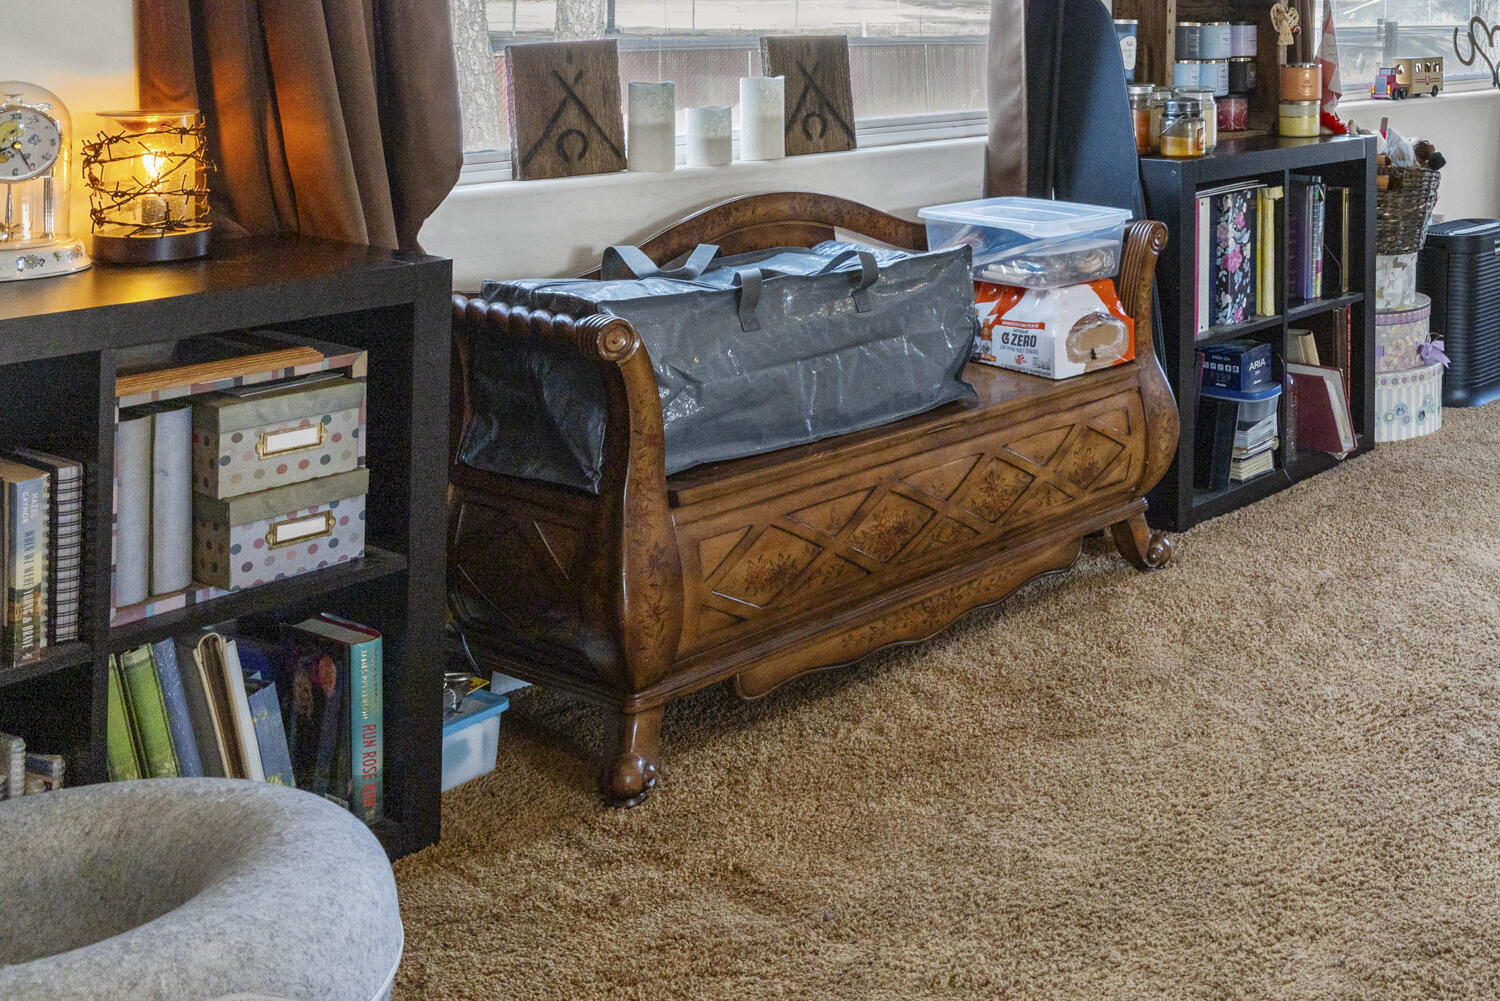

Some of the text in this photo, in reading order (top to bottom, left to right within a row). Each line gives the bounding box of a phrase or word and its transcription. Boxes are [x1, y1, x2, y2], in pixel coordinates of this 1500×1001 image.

[1010, 333, 1037, 348] ZERO
[1249, 358, 1266, 372] ARIA
[22, 589, 34, 616] YOUNG
[362, 724, 377, 748] RUN
[362, 751, 377, 780] ROSE
